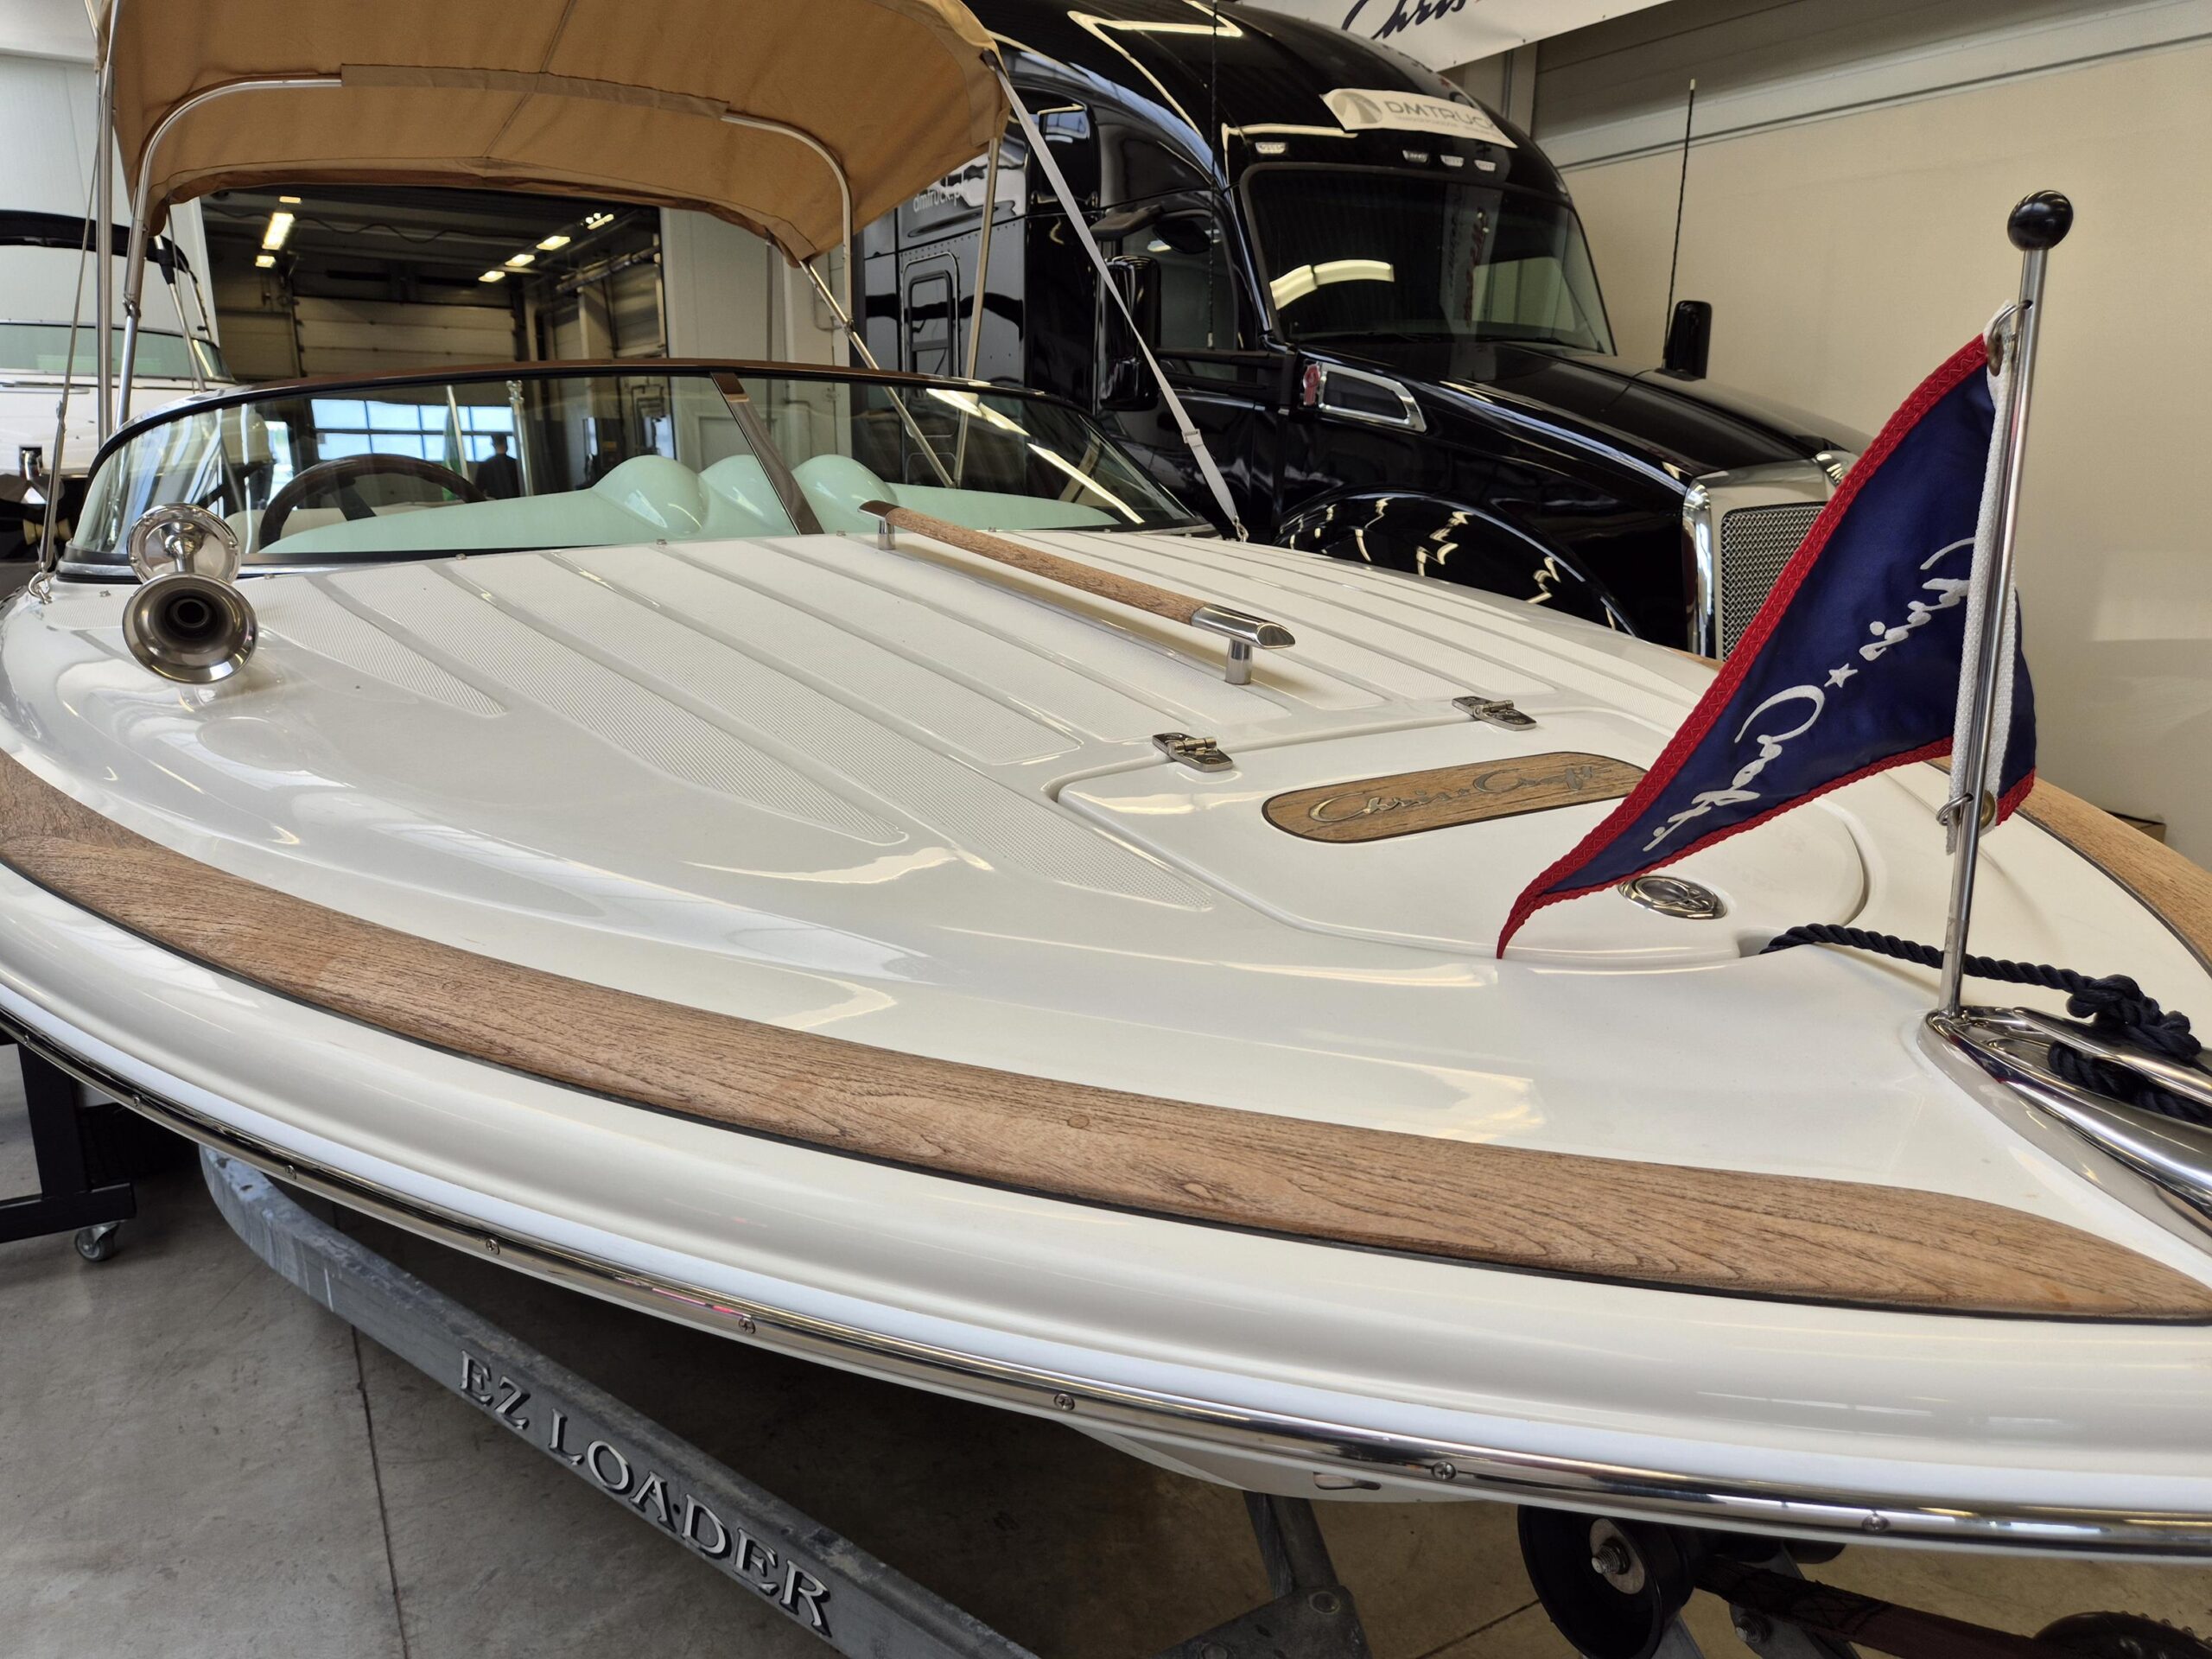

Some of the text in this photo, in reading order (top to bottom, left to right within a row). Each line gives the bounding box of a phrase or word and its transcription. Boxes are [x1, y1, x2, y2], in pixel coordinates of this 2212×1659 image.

[1384, 100, 1495, 129] DMTRUC
[460, 1349, 834, 1639] EZ LOADER
